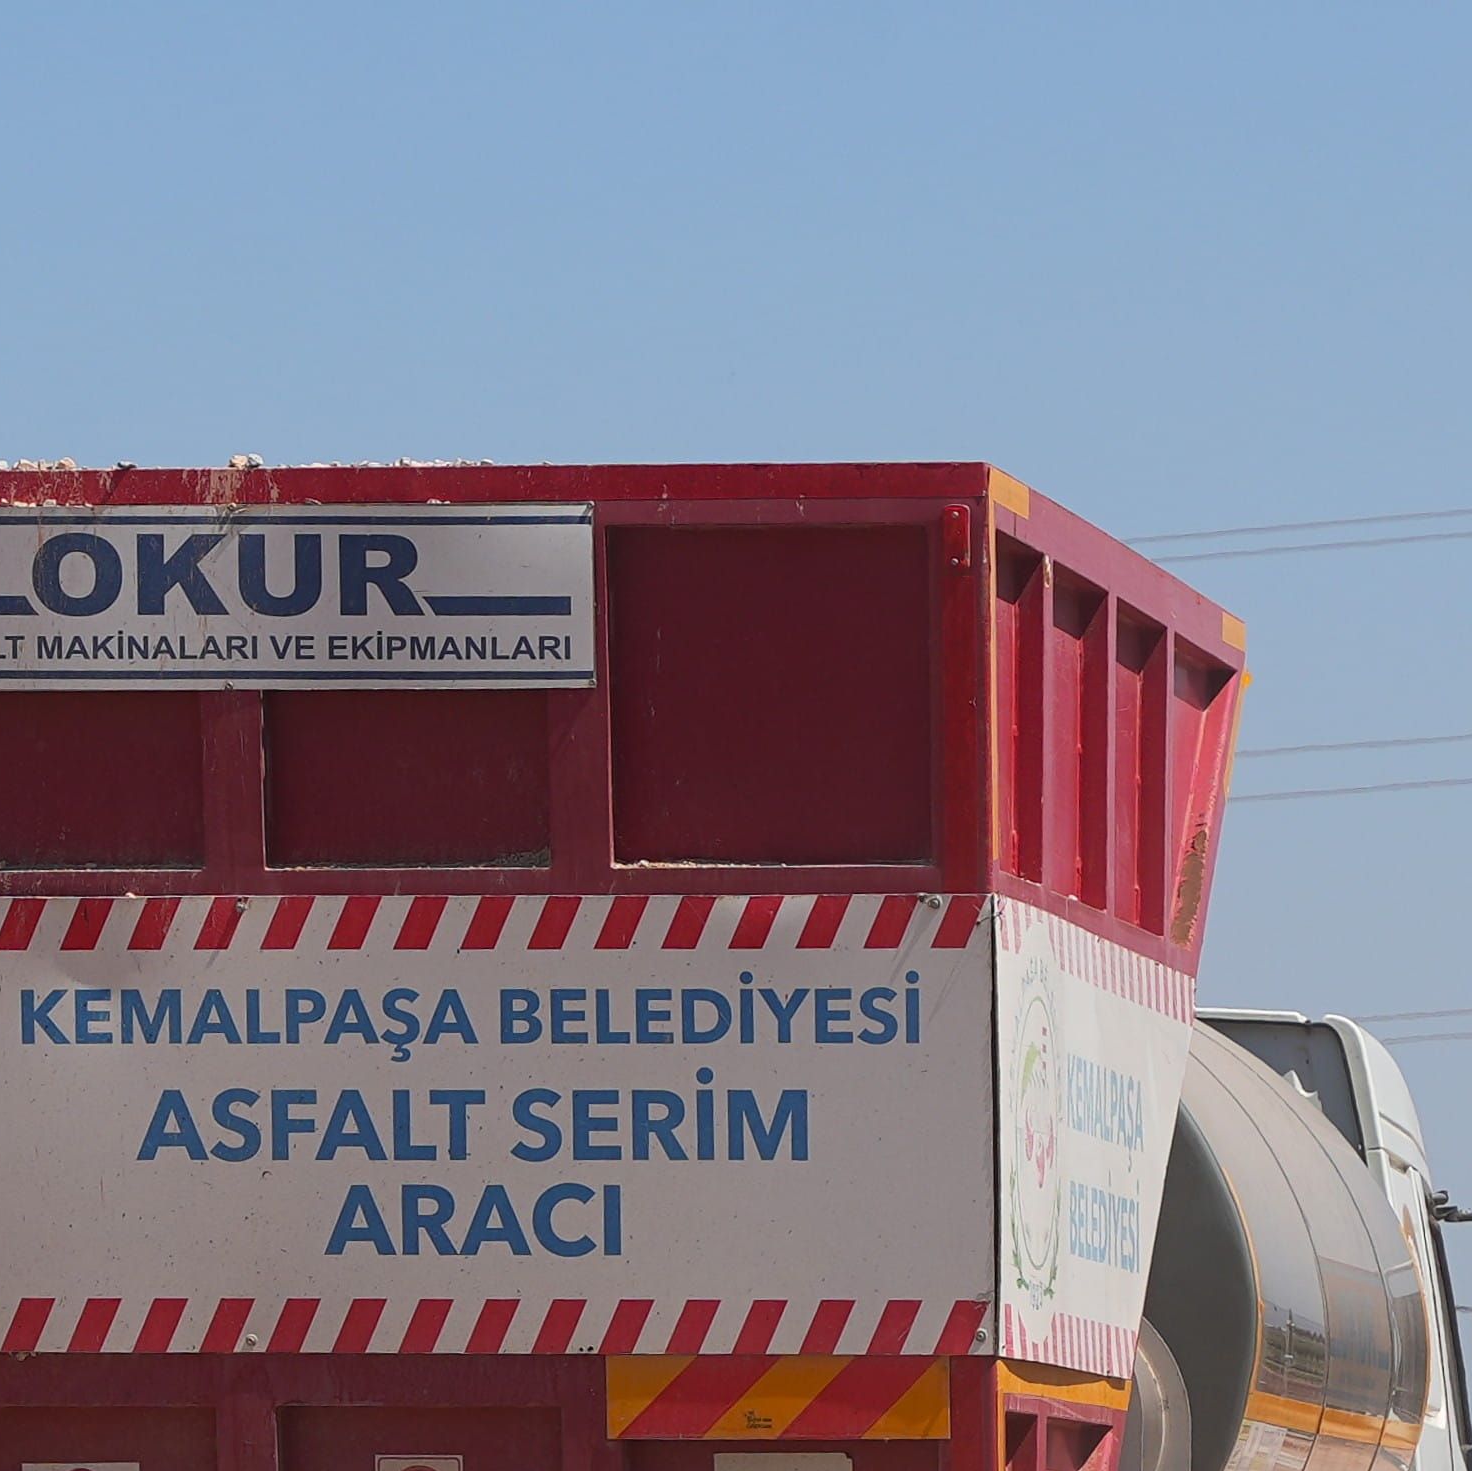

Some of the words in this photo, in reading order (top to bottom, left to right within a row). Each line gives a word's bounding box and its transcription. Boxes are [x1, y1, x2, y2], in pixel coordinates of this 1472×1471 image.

[31, 532, 419, 617] OKUR
[35, 630, 259, 661] MAKİNALARI
[270, 635, 316, 661] VE
[328, 629, 572, 661] EKİPMANLARI
[20, 987, 478, 1063] KEMALPAŞA
[499, 970, 921, 1046] BELEDİYESİ
[136, 1087, 486, 1162] ASFALT
[510, 1066, 809, 1162] SERİM
[1066, 1052, 1144, 1173] KEMALPAŞA
[324, 1182, 623, 1257] ARACI
[1069, 1168, 1141, 1275] BELEDİYESİ
